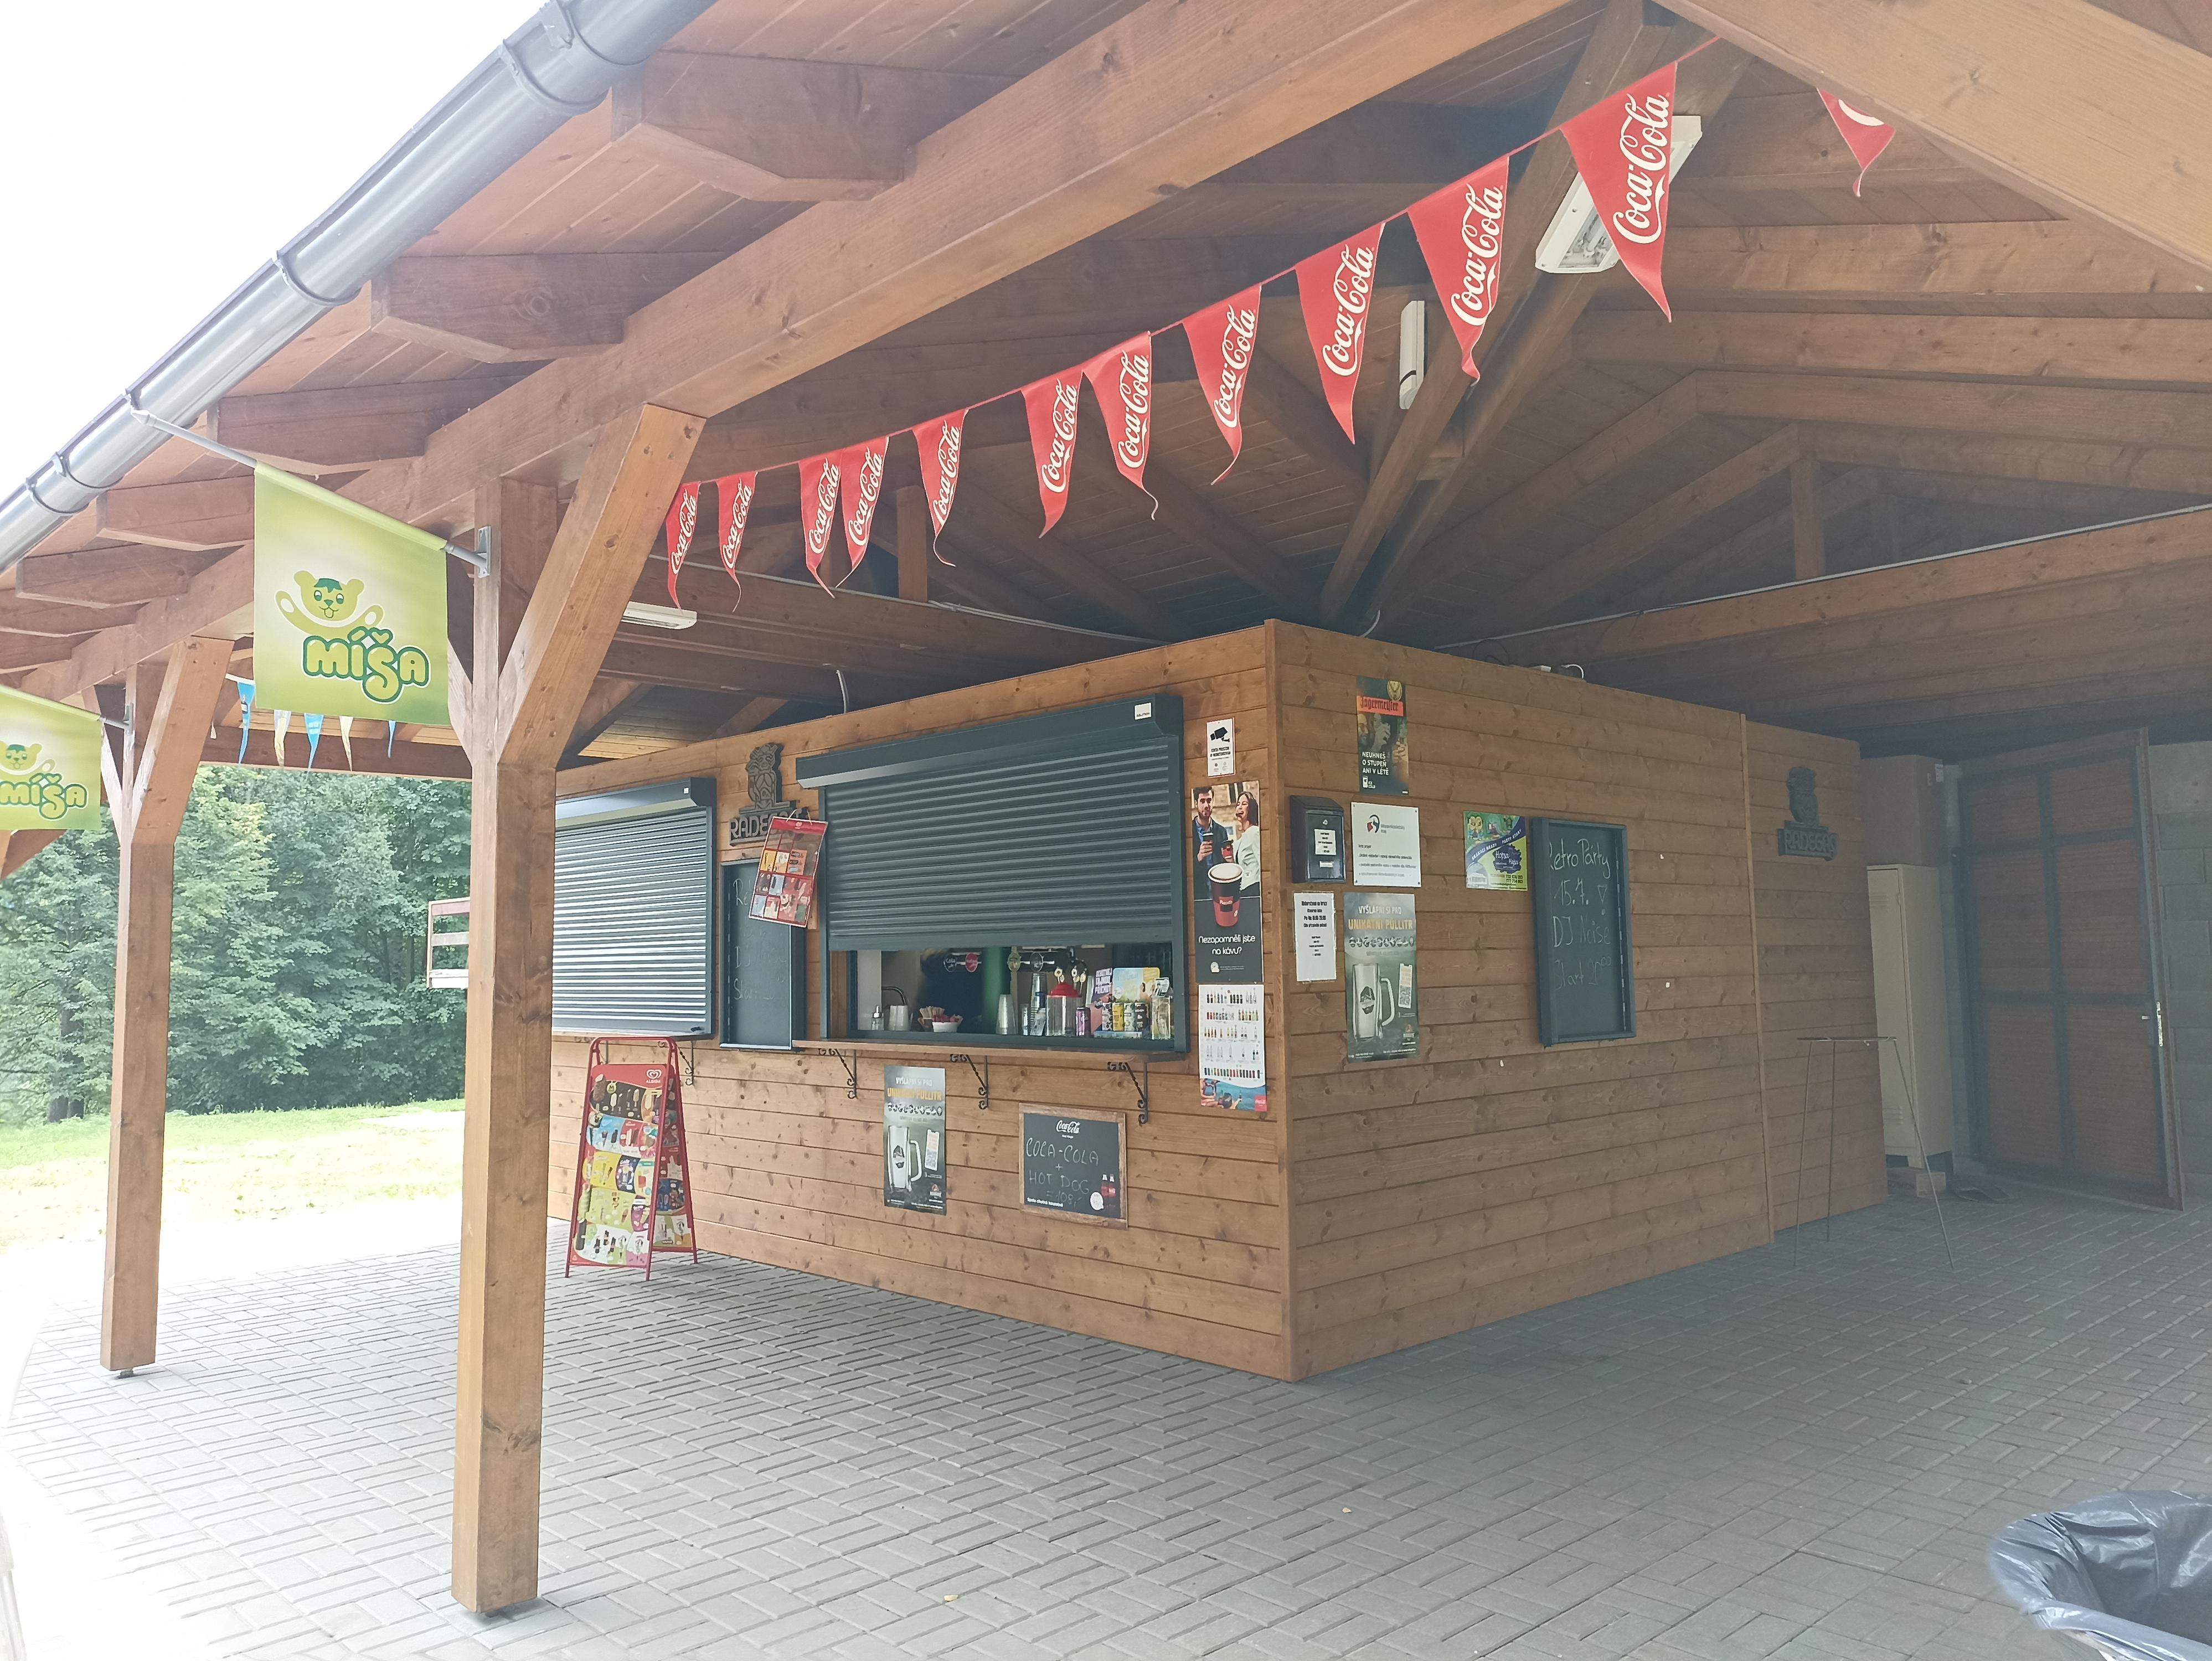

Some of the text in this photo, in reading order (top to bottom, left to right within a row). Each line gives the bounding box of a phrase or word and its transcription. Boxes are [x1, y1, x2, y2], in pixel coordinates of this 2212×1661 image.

[1612, 93, 1669, 244] Coca-Cola
[1322, 244, 1374, 376] Coca-Cola
[1451, 183, 1503, 326] Coca-Cola
[1118, 350, 1149, 468] Coca-Cola
[1213, 304, 1256, 428] Coca-Cola
[931, 421, 960, 538] Coca-Cola
[1041, 379, 1077, 493] Coca-Cola
[809, 458, 839, 554] Coca-Cola
[848, 447, 883, 551] Coca-Cola
[1242, 935, 1256, 944] jste
[1026, 1137, 1099, 1165] COCA-COLA
[1029, 1169, 1089, 1194] HOT DOG
